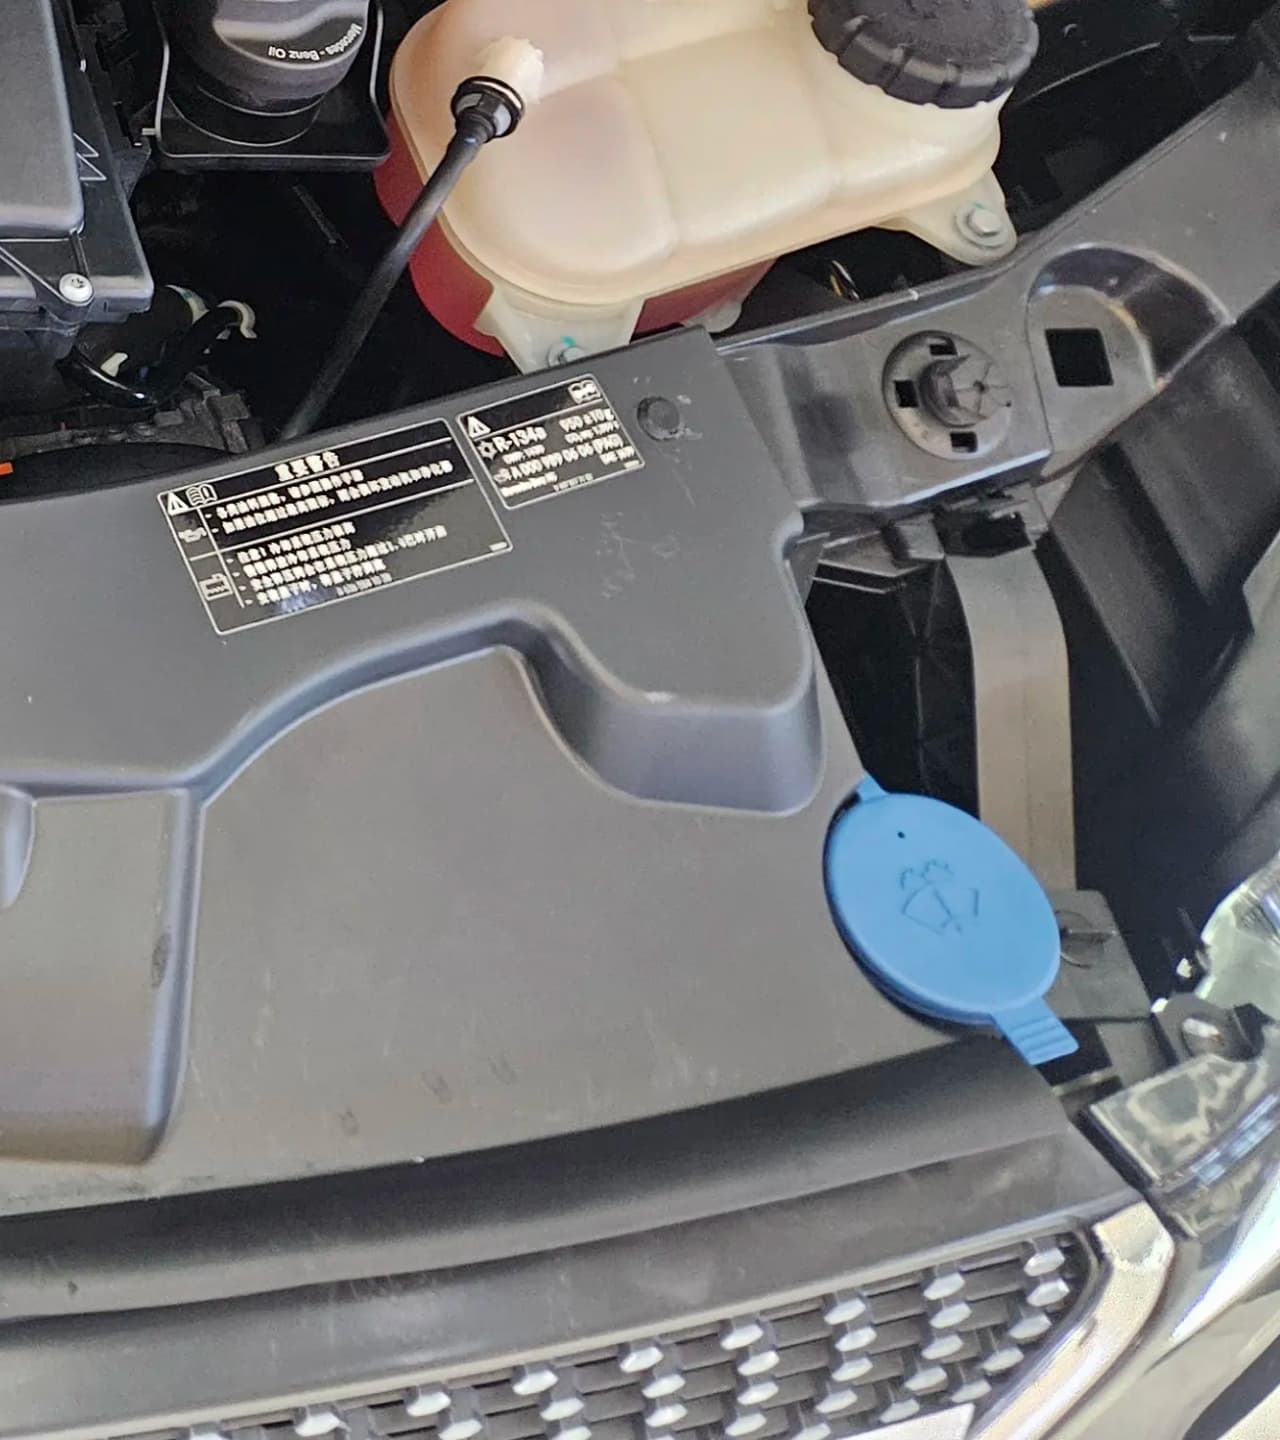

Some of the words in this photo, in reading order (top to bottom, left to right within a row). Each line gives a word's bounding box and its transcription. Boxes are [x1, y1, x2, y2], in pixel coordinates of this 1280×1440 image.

[268, 46, 286, 58] Oil
[289, 50, 320, 61] Benz
[492, 426, 547, 453] R-134a
